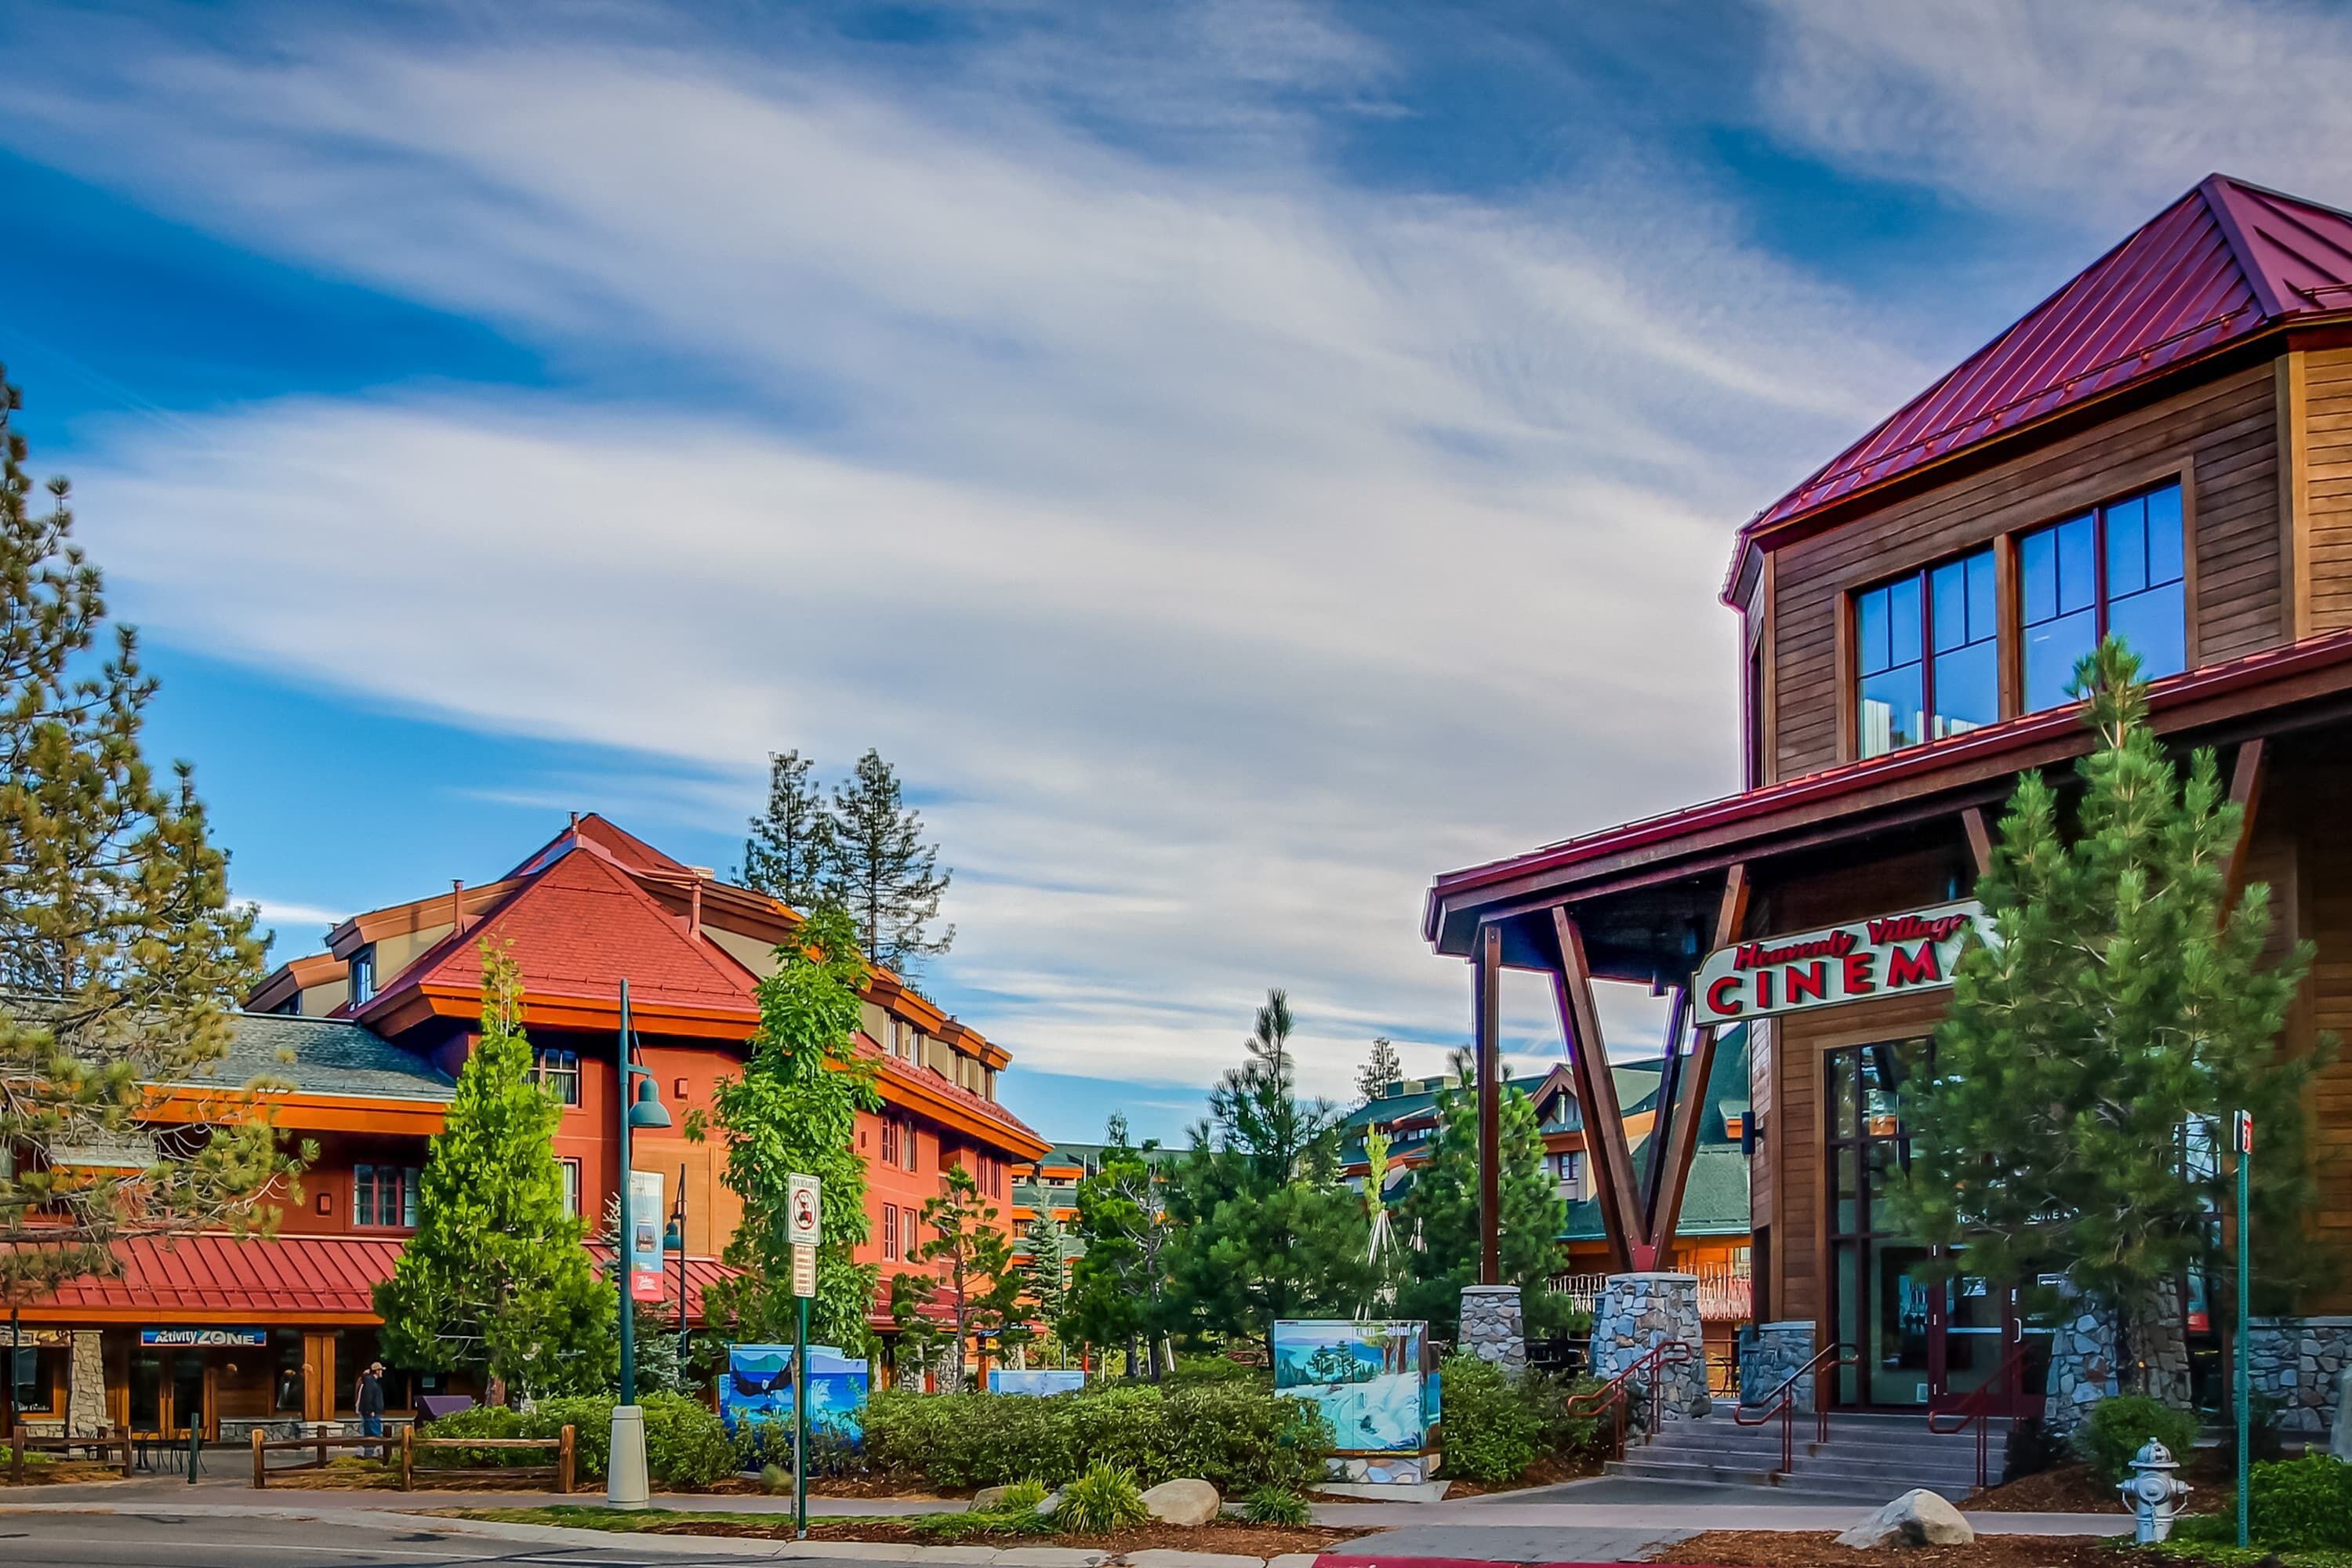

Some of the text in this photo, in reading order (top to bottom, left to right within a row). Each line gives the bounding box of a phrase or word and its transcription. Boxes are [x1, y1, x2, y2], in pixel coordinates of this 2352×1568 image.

[1733, 913, 1970, 971] Heavenly Village
[154, 1330, 255, 1345] Activity ZONE
